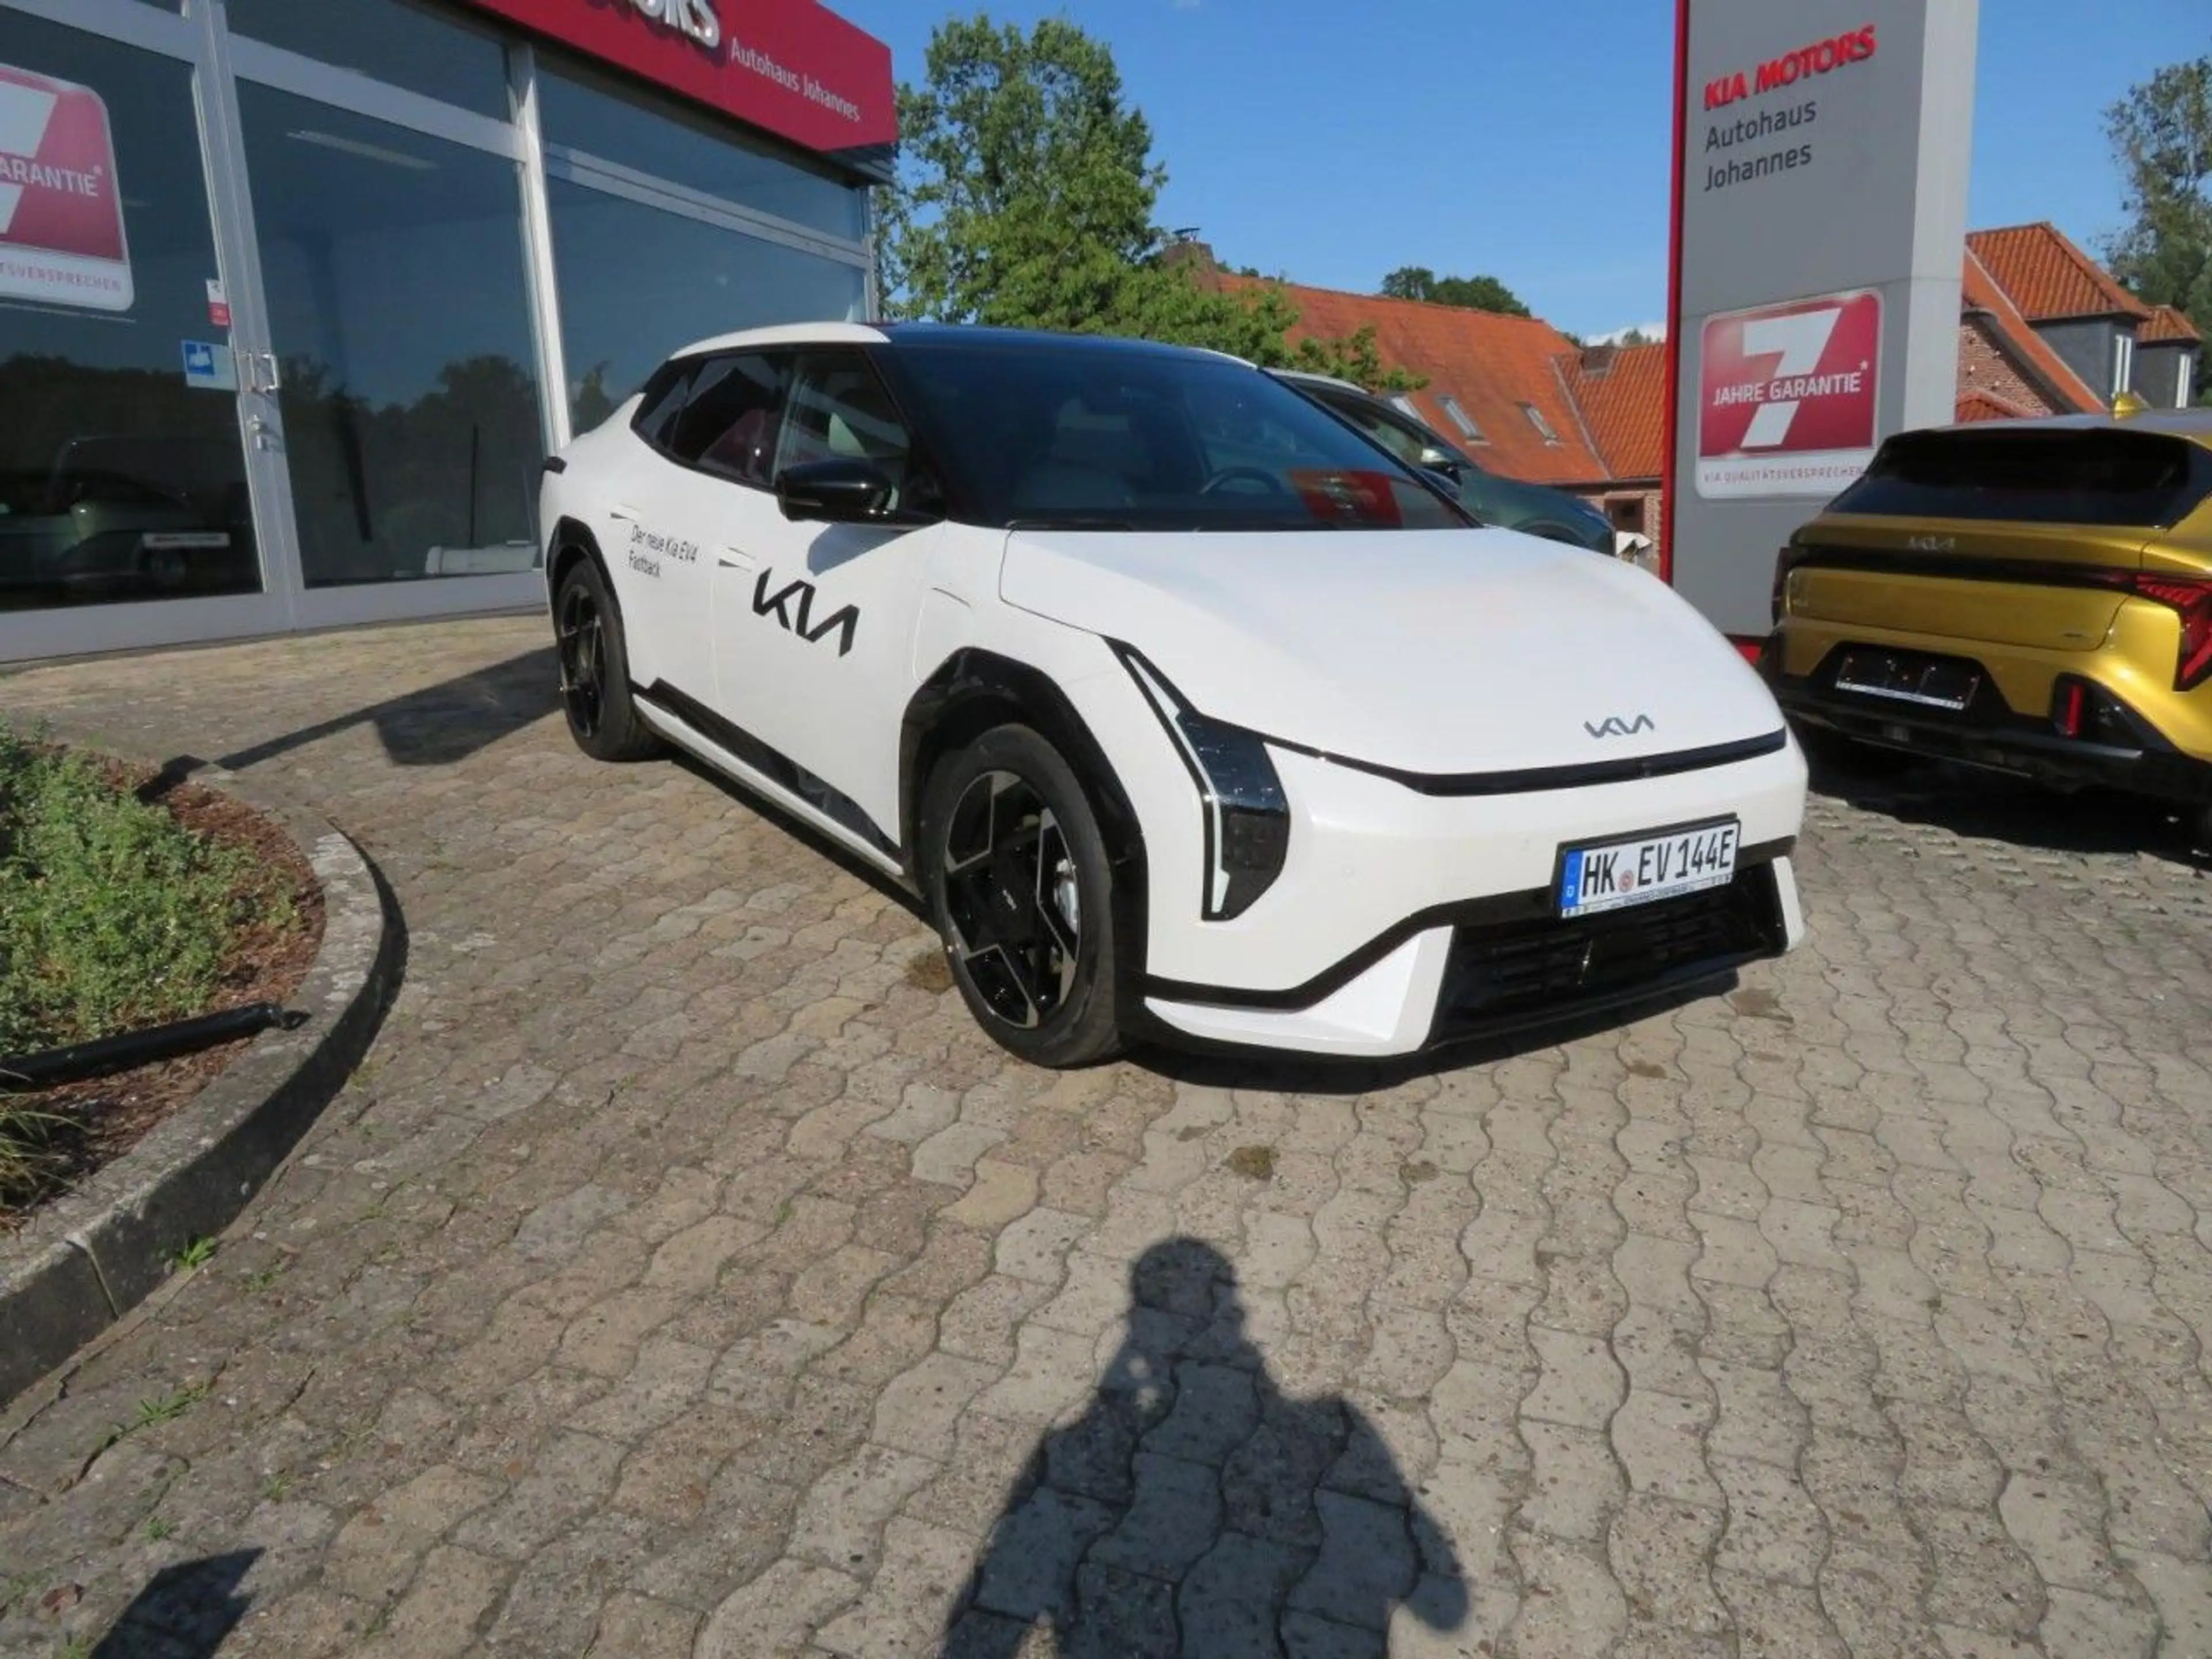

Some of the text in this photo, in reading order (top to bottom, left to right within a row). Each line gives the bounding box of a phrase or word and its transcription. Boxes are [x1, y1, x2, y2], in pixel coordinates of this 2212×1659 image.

[731, 36, 860, 123] Autohaus Johannes
[1704, 24, 1876, 111] KIA MOTORS
[1705, 101, 1817, 153] Autohaus
[1704, 144, 1812, 192] Johannes
[1713, 382, 1764, 406] JAHRE
[1740, 307, 1843, 449] 7
[630, 524, 645, 544] Der
[752, 567, 859, 658] KIA
[1582, 714, 1655, 738] KIA
[1582, 851, 1619, 897] HK
[1675, 830, 1734, 879] 144E
